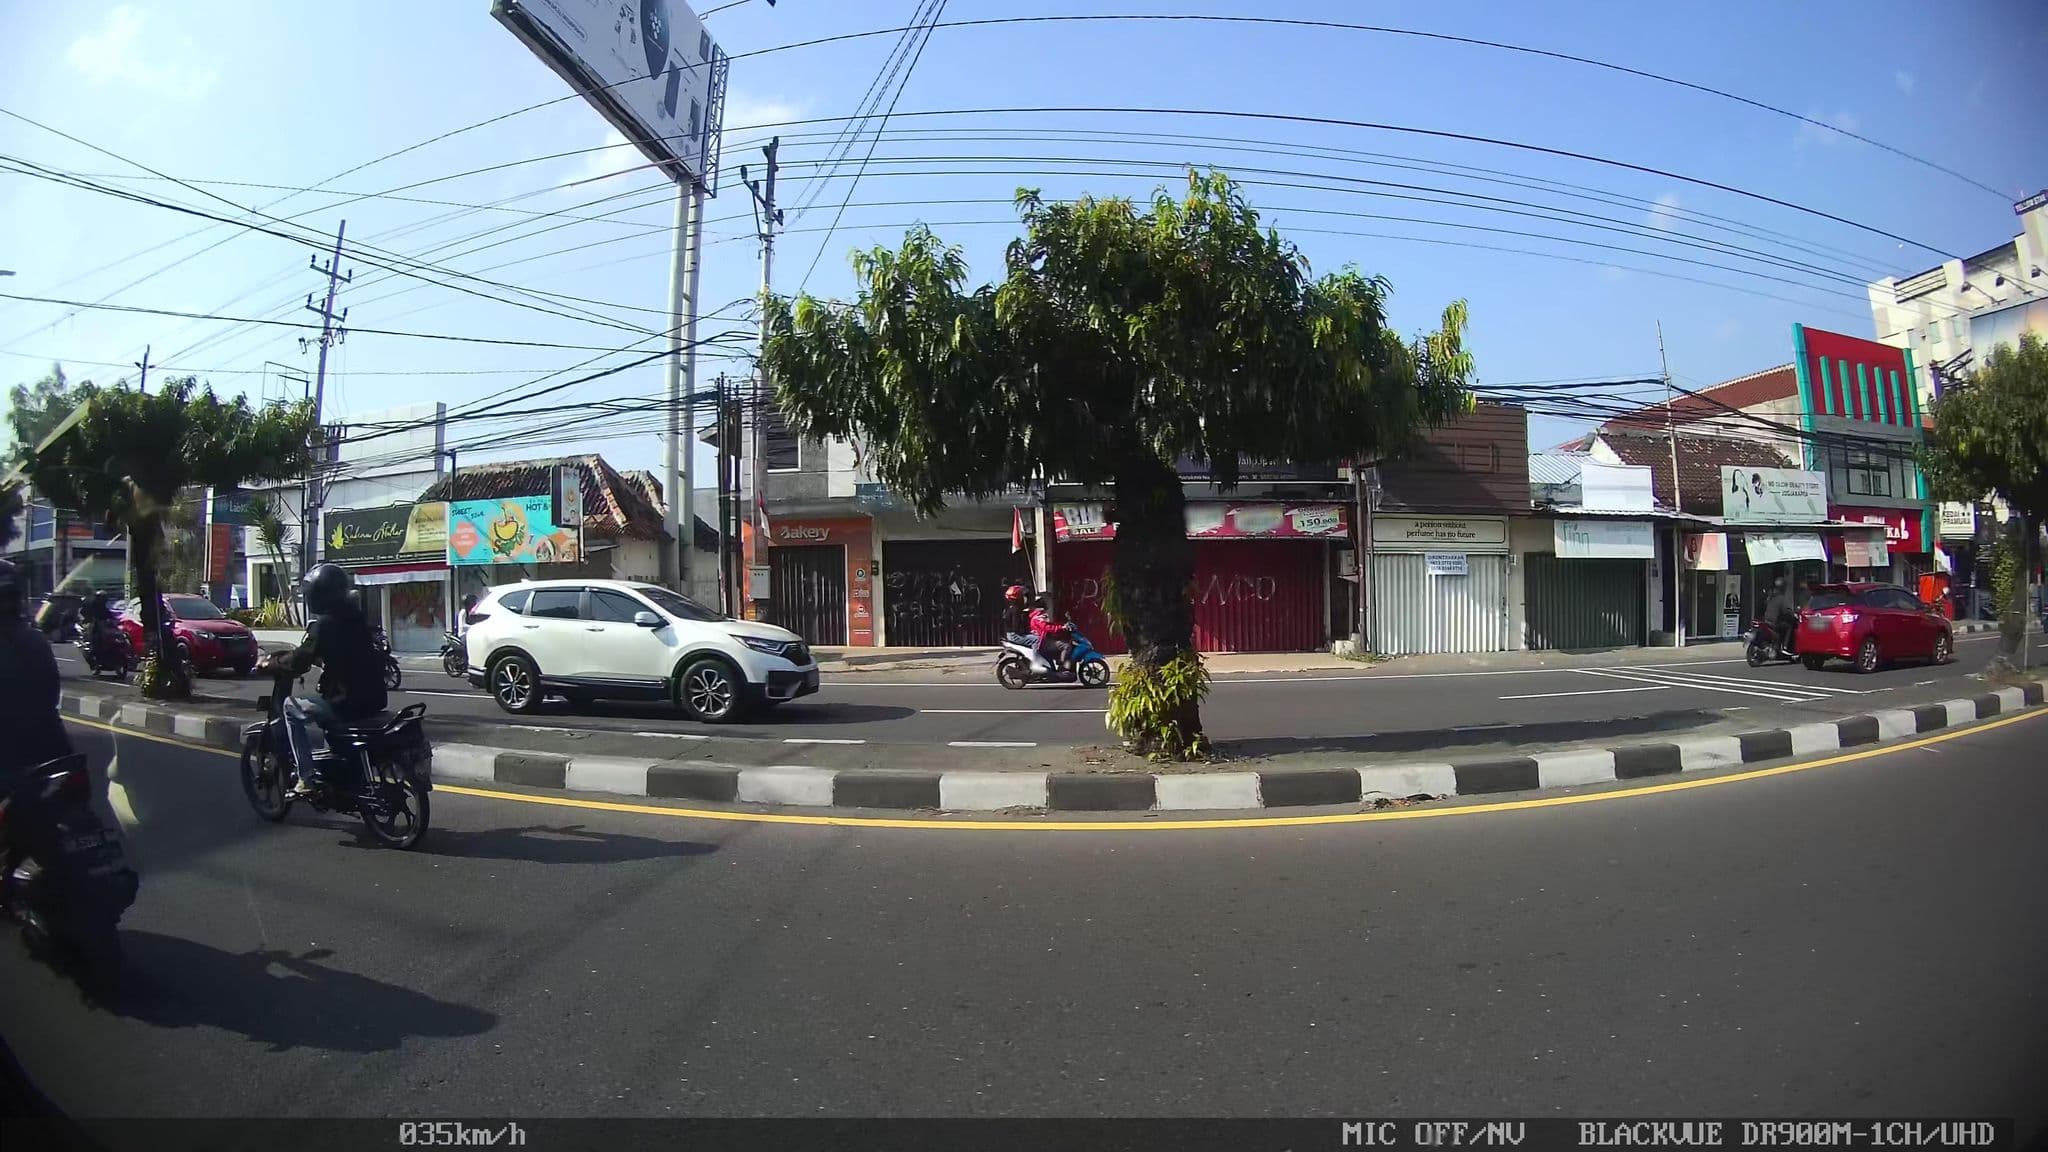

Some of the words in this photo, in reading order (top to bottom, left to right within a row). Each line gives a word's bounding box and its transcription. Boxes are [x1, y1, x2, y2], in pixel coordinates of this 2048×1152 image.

[526, 503, 543, 511] HOT
[781, 526, 830, 541] Bakery
[1407, 530, 1434, 538] perfume
